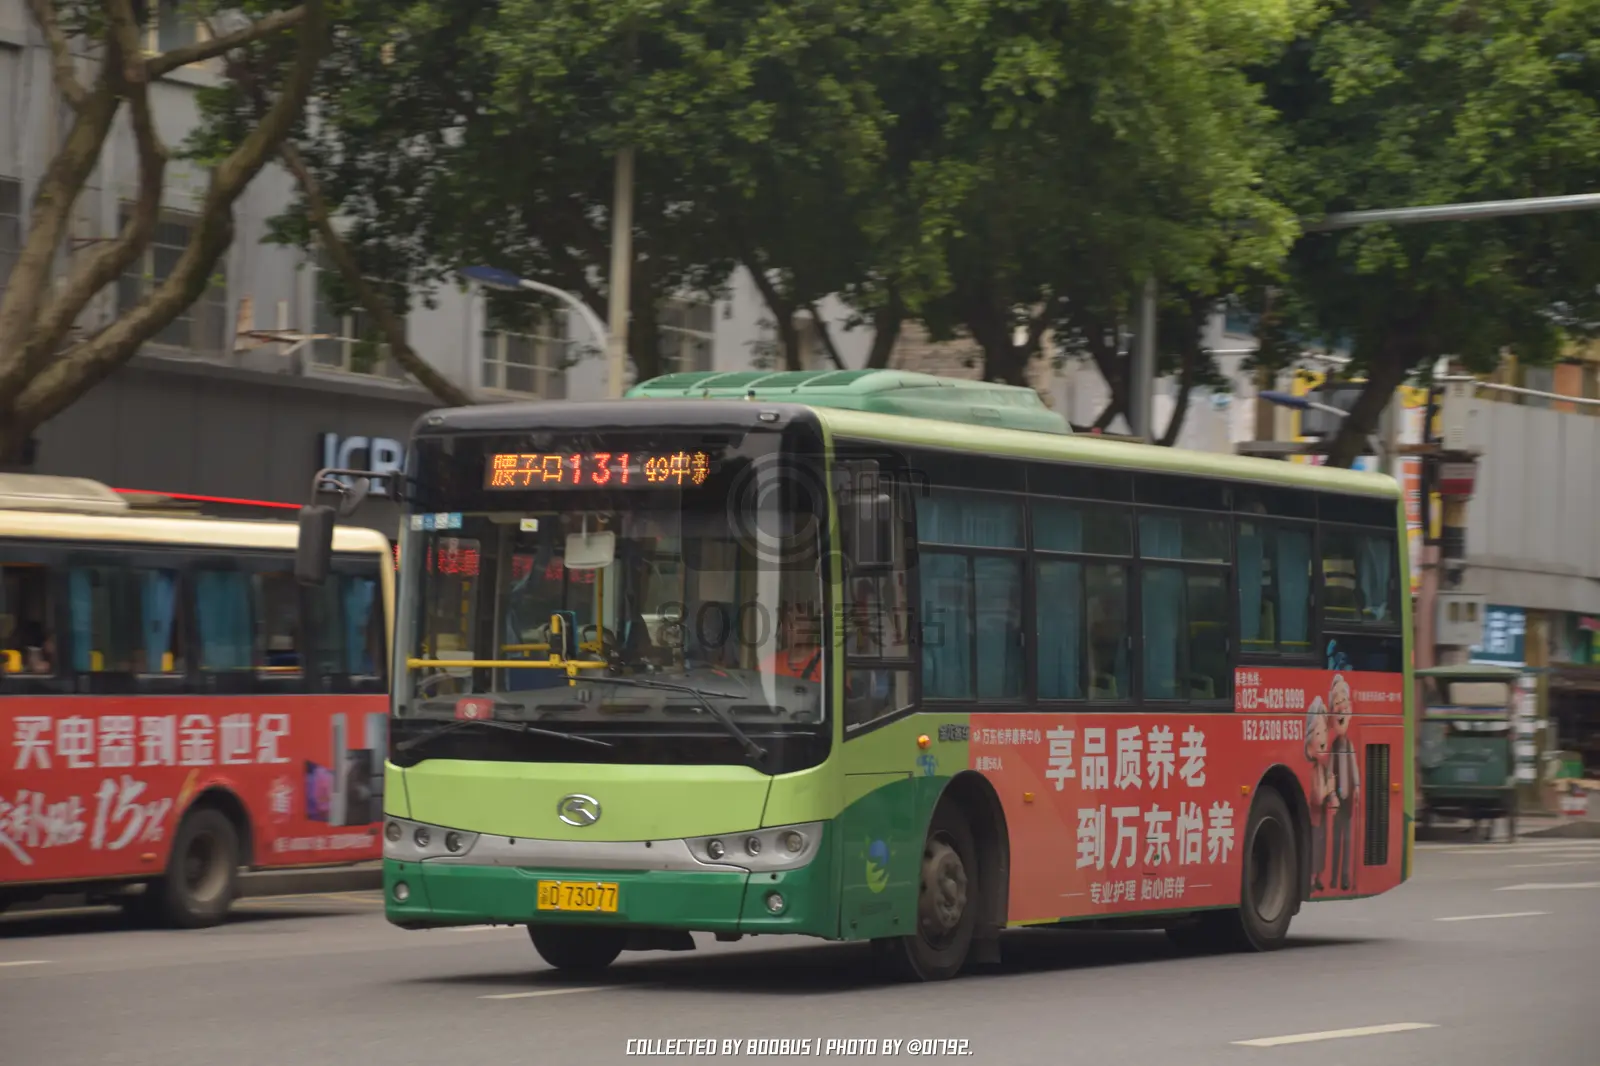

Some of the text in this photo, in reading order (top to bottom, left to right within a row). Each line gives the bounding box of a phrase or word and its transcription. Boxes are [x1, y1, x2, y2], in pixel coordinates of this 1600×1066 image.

[491, 453, 563, 487] 腰子口
[569, 453, 630, 484] 131
[12, 712, 291, 770] 买电器到金世纪
[1242, 719, 1258, 740] 152
[1045, 724, 1207, 792] 享品质养老
[1075, 800, 1235, 871] 到万东怡养
[1089, 876, 1186, 905] 专业护理 贴心陪伴
